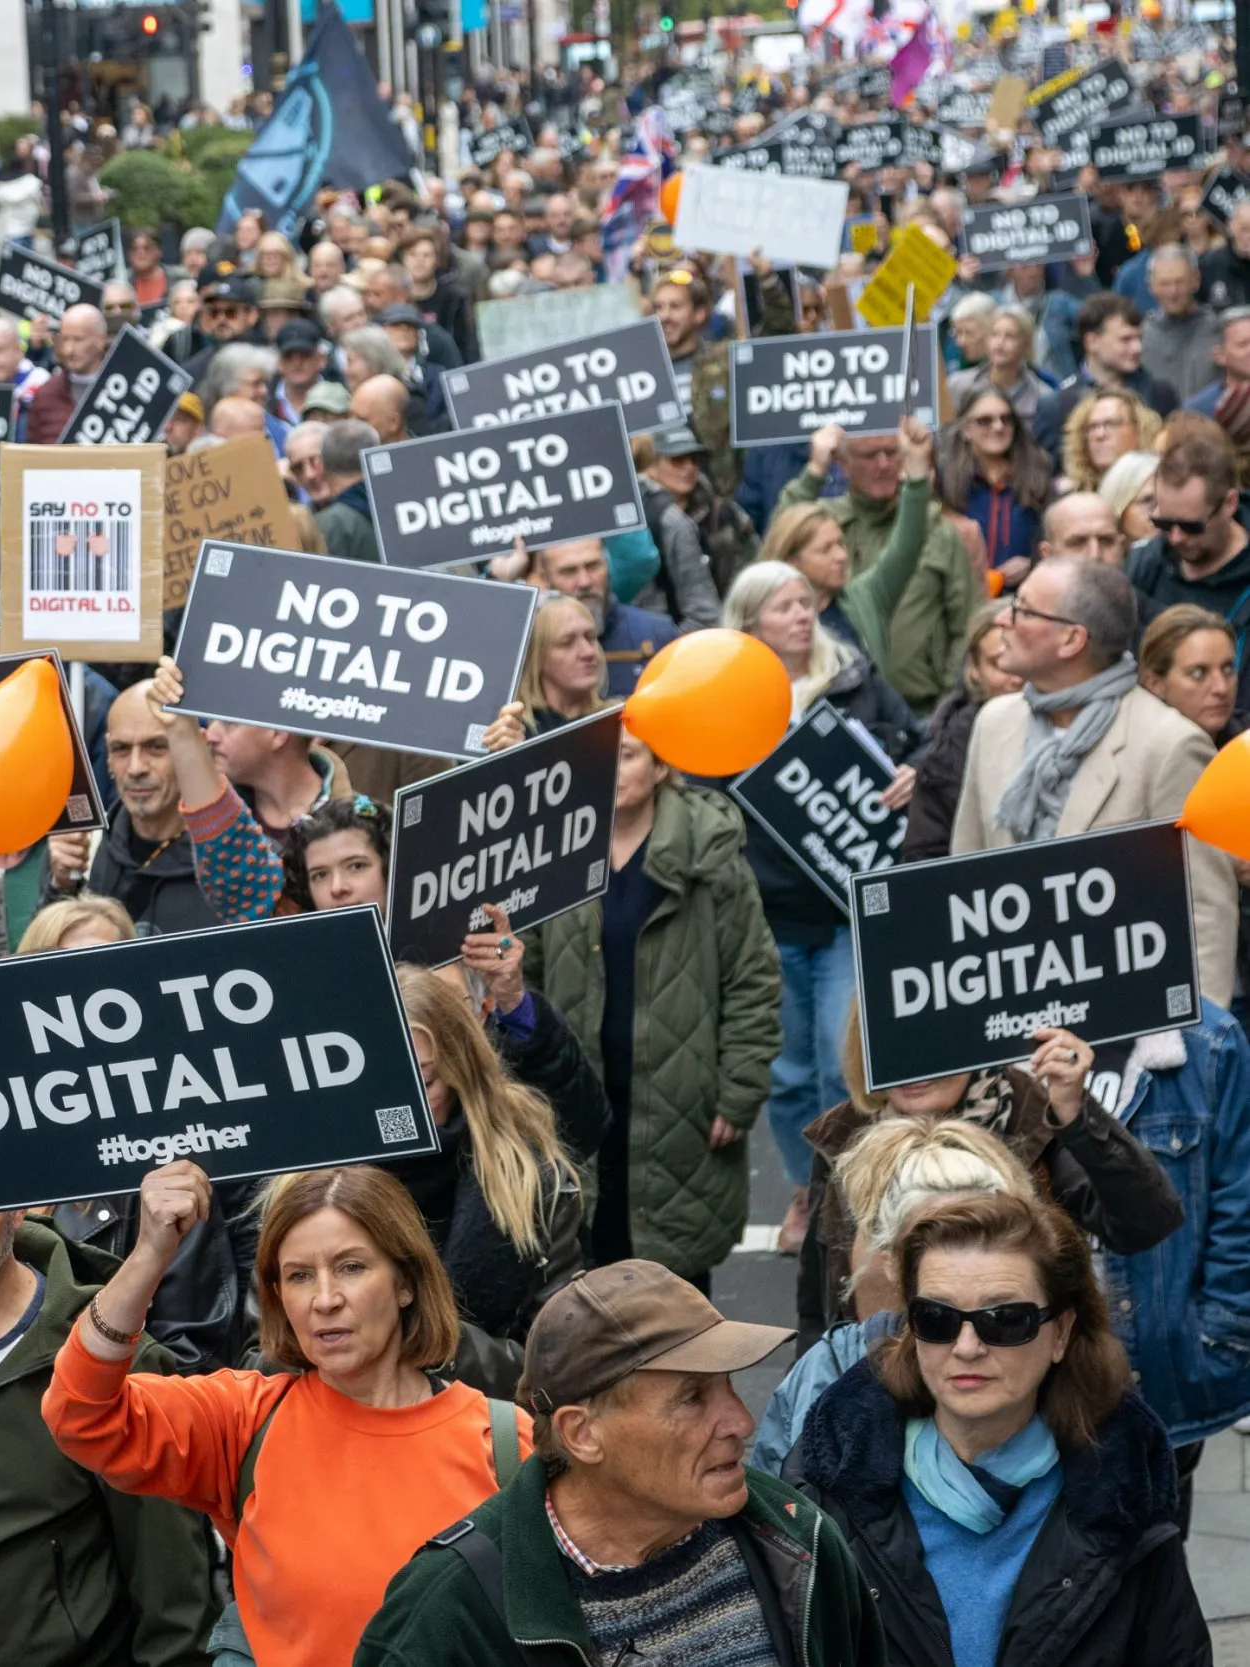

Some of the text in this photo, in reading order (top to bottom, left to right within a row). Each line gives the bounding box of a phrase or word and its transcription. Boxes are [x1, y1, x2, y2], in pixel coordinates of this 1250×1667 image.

[970, 225, 1054, 254] DIGITAL
[1053, 219, 1080, 242] ID
[990, 203, 1059, 231] NO TO
[23, 262, 81, 303] NO TO
[503, 347, 617, 401] NO TO
[783, 344, 889, 380] NO TO
[94, 373, 129, 414] TO
[131, 367, 161, 403] ID
[616, 371, 657, 404] ID
[747, 376, 877, 415] DIGITAL
[435, 433, 569, 488] NO TO
[29, 502, 66, 517] SAY
[104, 502, 132, 517] TO
[190, 474, 231, 508] GOV
[395, 464, 613, 535] DIGITAL ID
[470, 516, 553, 546] #together
[29, 597, 135, 613] DIGITAL I.D.
[275, 580, 448, 643] NO TO
[203, 621, 484, 702] DIGITAL ID
[279, 686, 388, 724] #together
[458, 760, 572, 845] NO TO
[834, 764, 891, 825] NO
[410, 804, 597, 921] DIGITAL ID
[949, 867, 1116, 943] NO TO
[890, 920, 1167, 1019] DIGITAL ID
[21, 968, 274, 1055] NO TO
[985, 1001, 1090, 1042] #together
[280, 1031, 366, 1092] ID
[97, 1122, 251, 1166] #together
